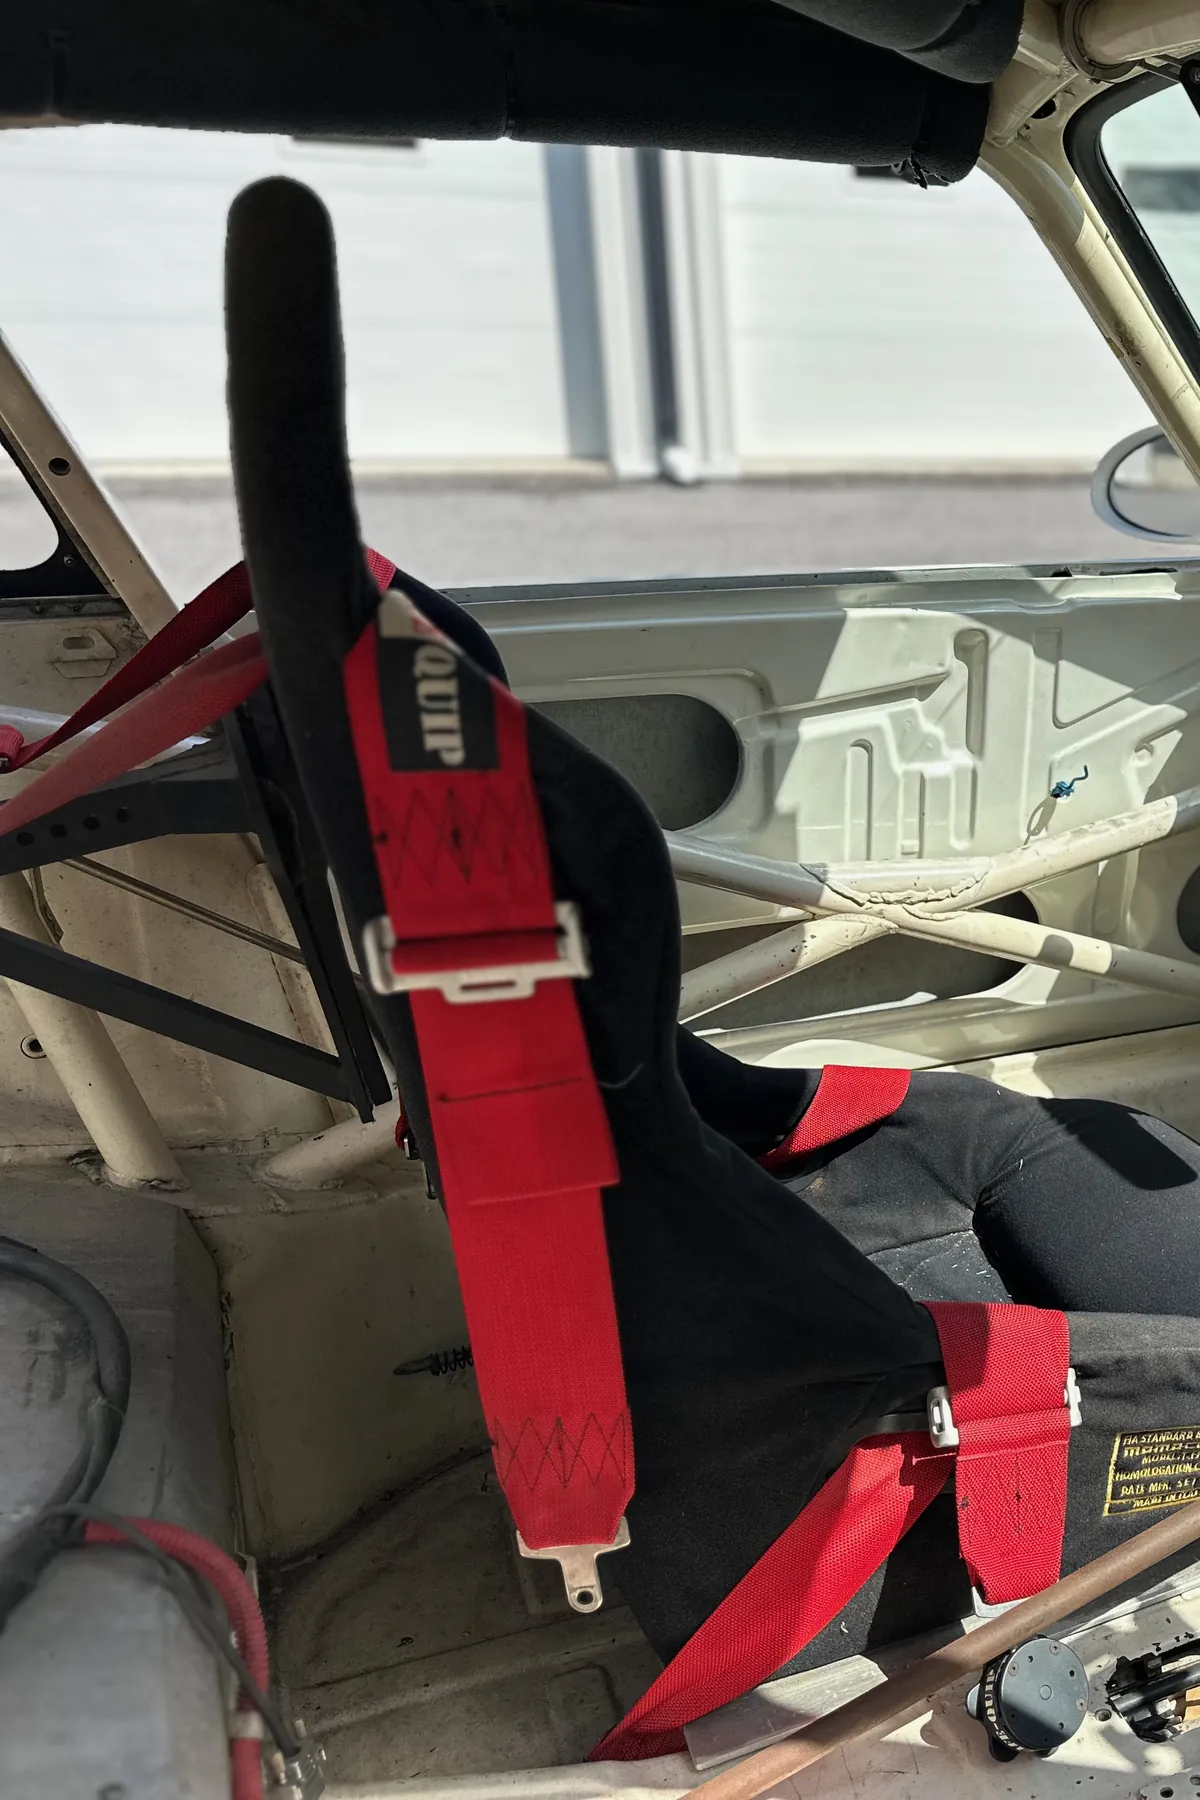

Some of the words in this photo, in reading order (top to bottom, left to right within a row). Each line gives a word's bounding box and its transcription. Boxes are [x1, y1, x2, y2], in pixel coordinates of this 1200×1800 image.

[413, 645, 466, 766] QUIP
[1123, 1435, 1138, 1446] FIA
[1140, 1430, 1194, 1444] STANDARD
[1120, 1483, 1145, 1496] DATE
